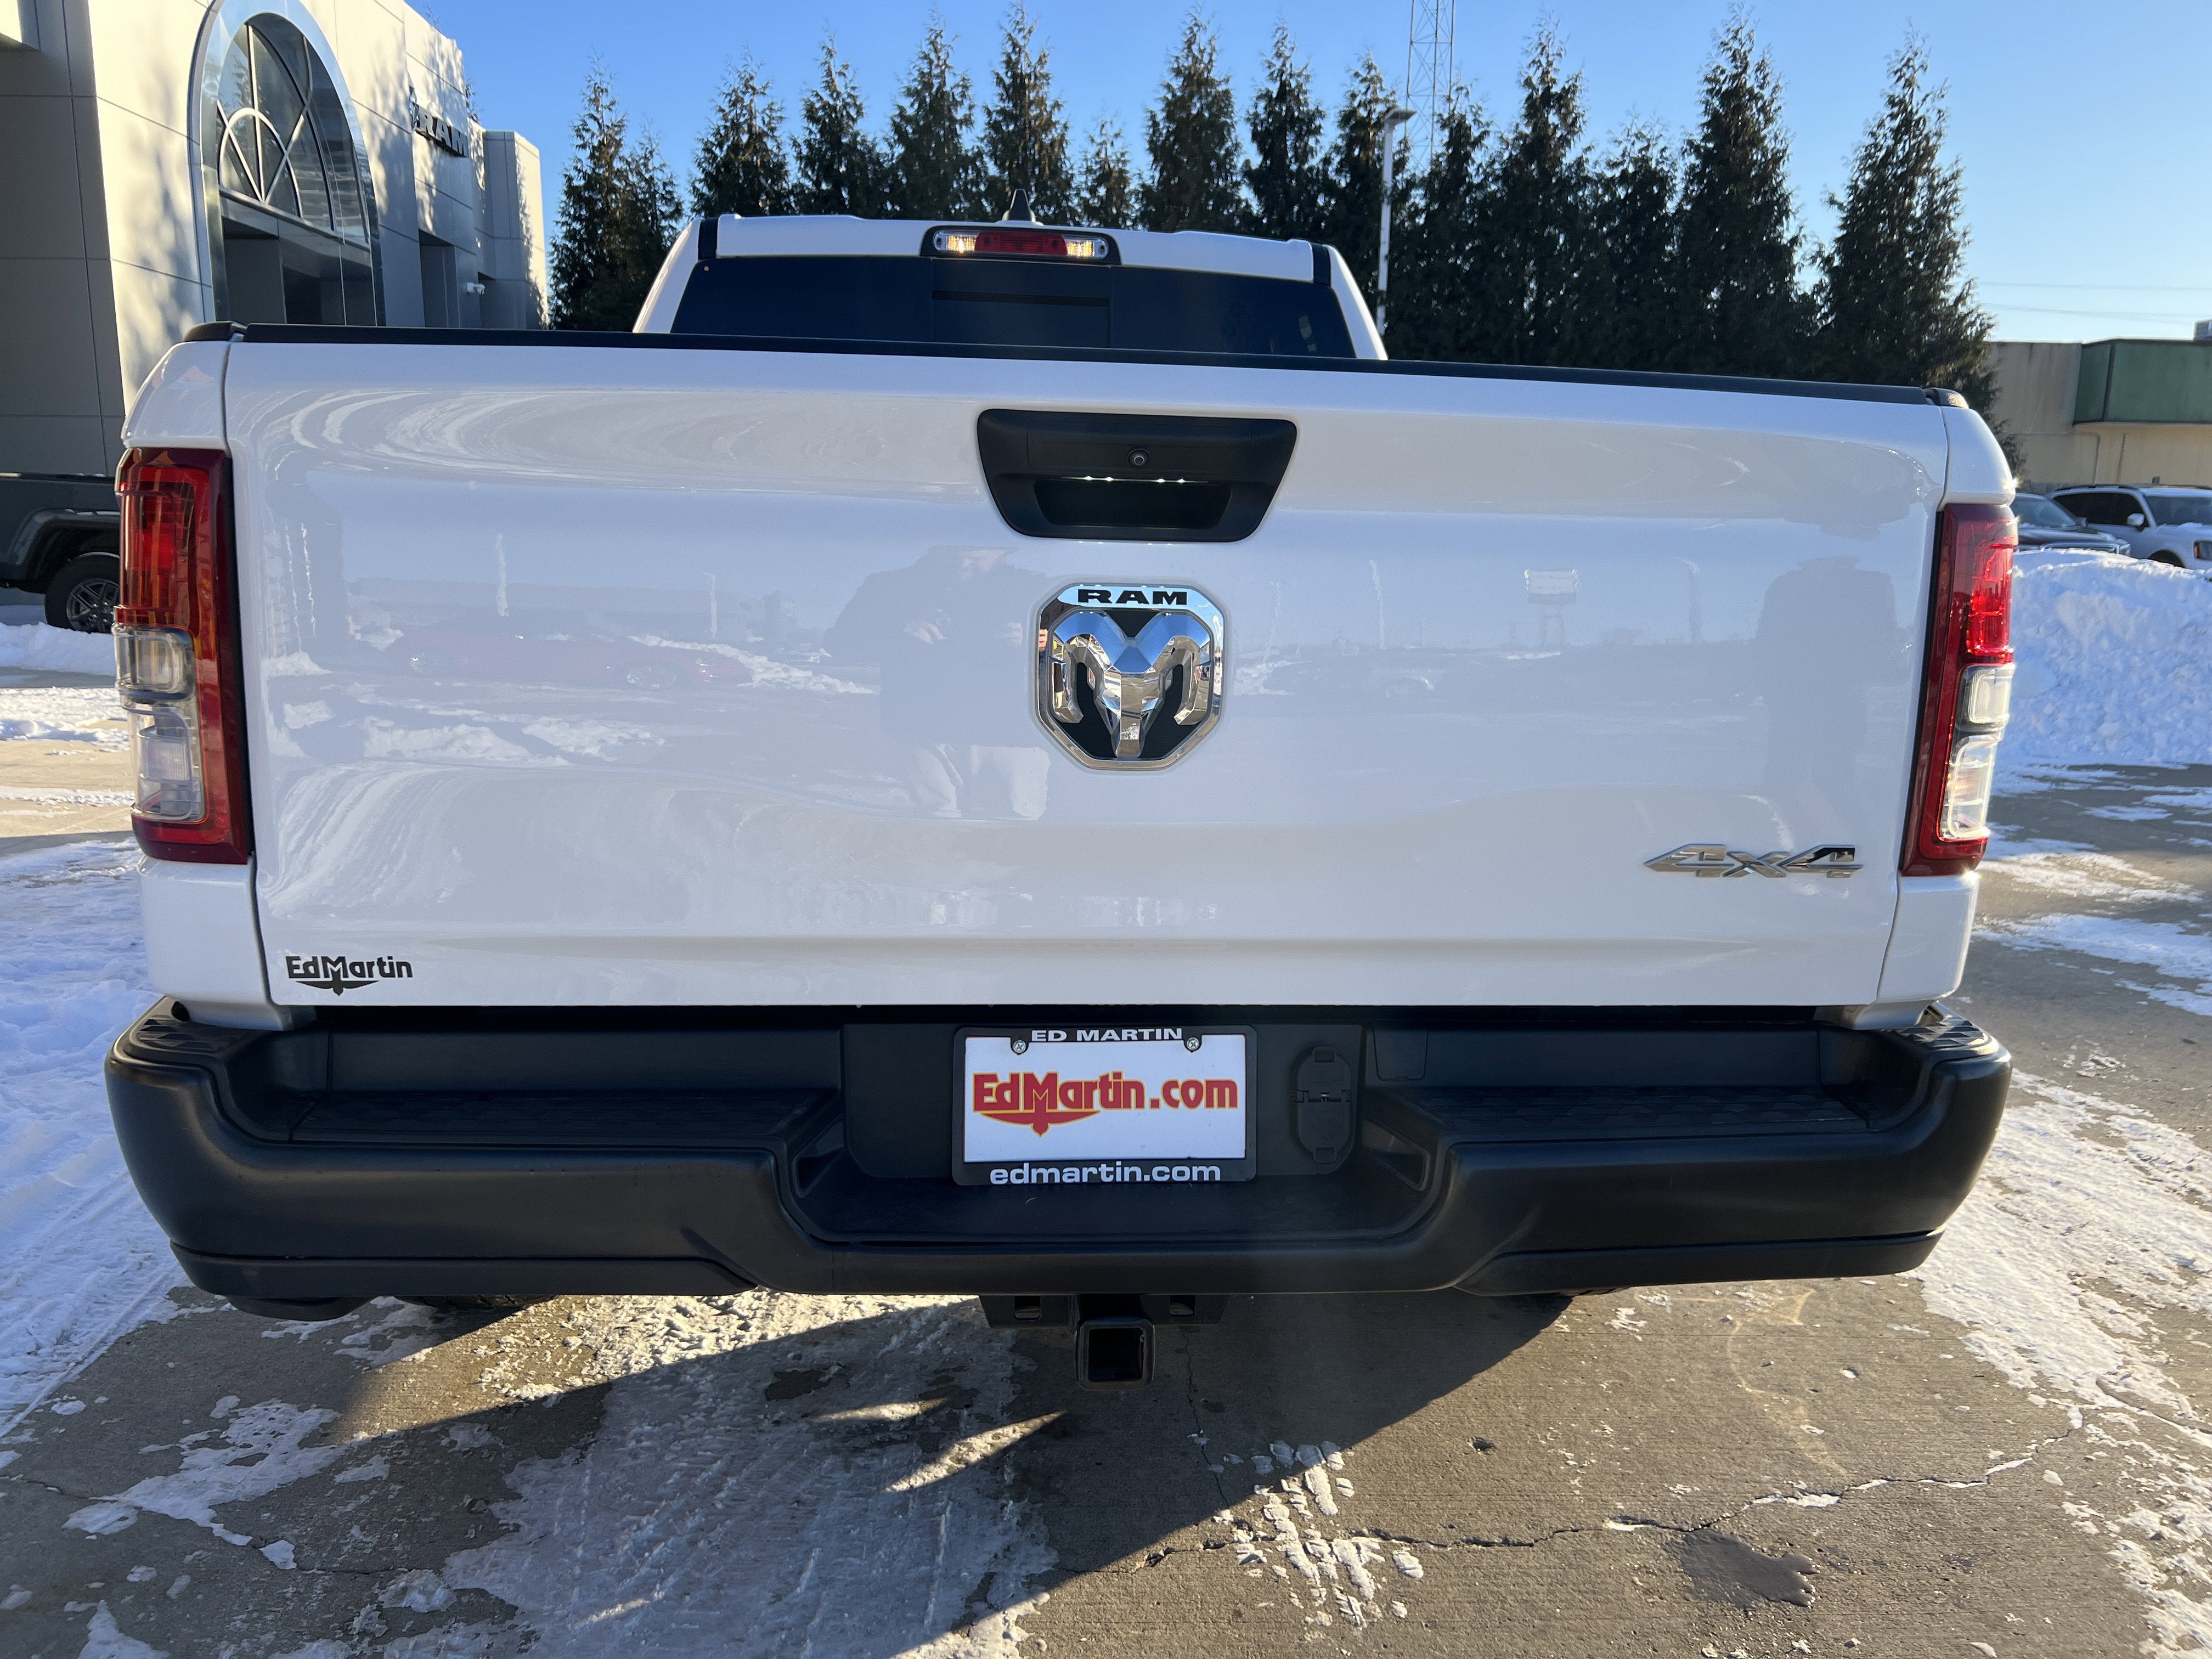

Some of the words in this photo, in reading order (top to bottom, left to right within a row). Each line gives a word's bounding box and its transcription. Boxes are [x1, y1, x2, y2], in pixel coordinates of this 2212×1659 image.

[416, 104, 468, 157] RAM
[1077, 589, 1187, 605] RAM
[285, 956, 413, 979] EdMartin
[1031, 1030, 1067, 1042] ED
[1076, 1028, 1182, 1041] MARTIN
[972, 1070, 1238, 1112] EdMartin.com
[990, 1161, 1221, 1184] edmartin.com
